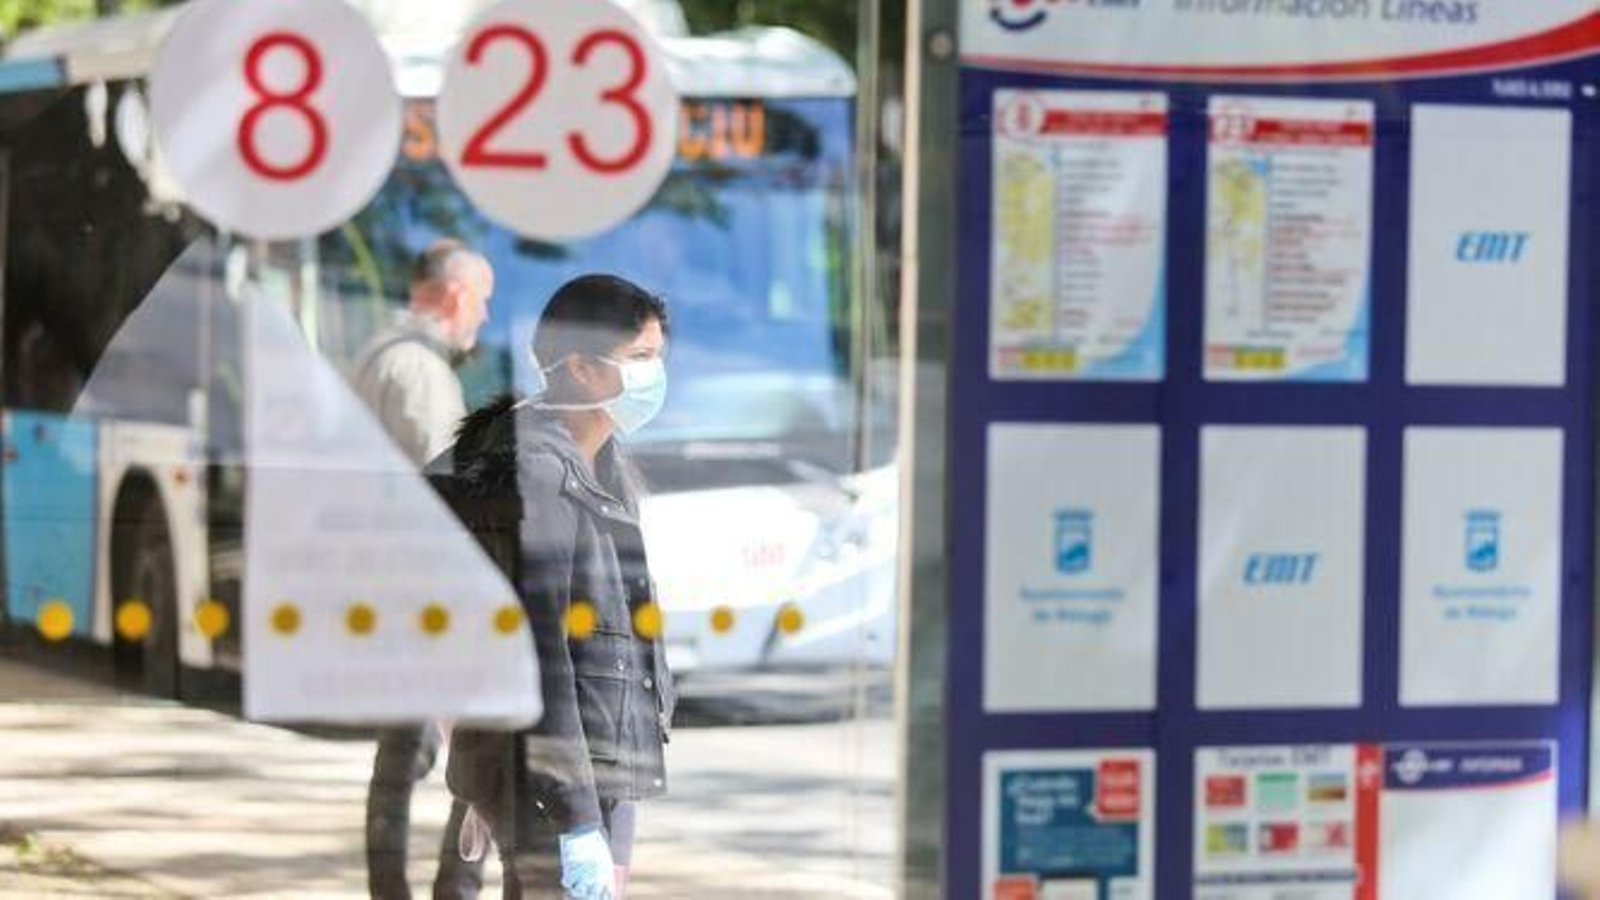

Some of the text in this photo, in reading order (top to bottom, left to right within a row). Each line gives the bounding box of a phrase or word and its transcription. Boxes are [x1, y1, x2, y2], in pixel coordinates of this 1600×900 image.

[236, 32, 330, 181] 8
[460, 24, 654, 176] 23
[1455, 231, 1532, 263] EMT
[1243, 552, 1320, 585] EMT
